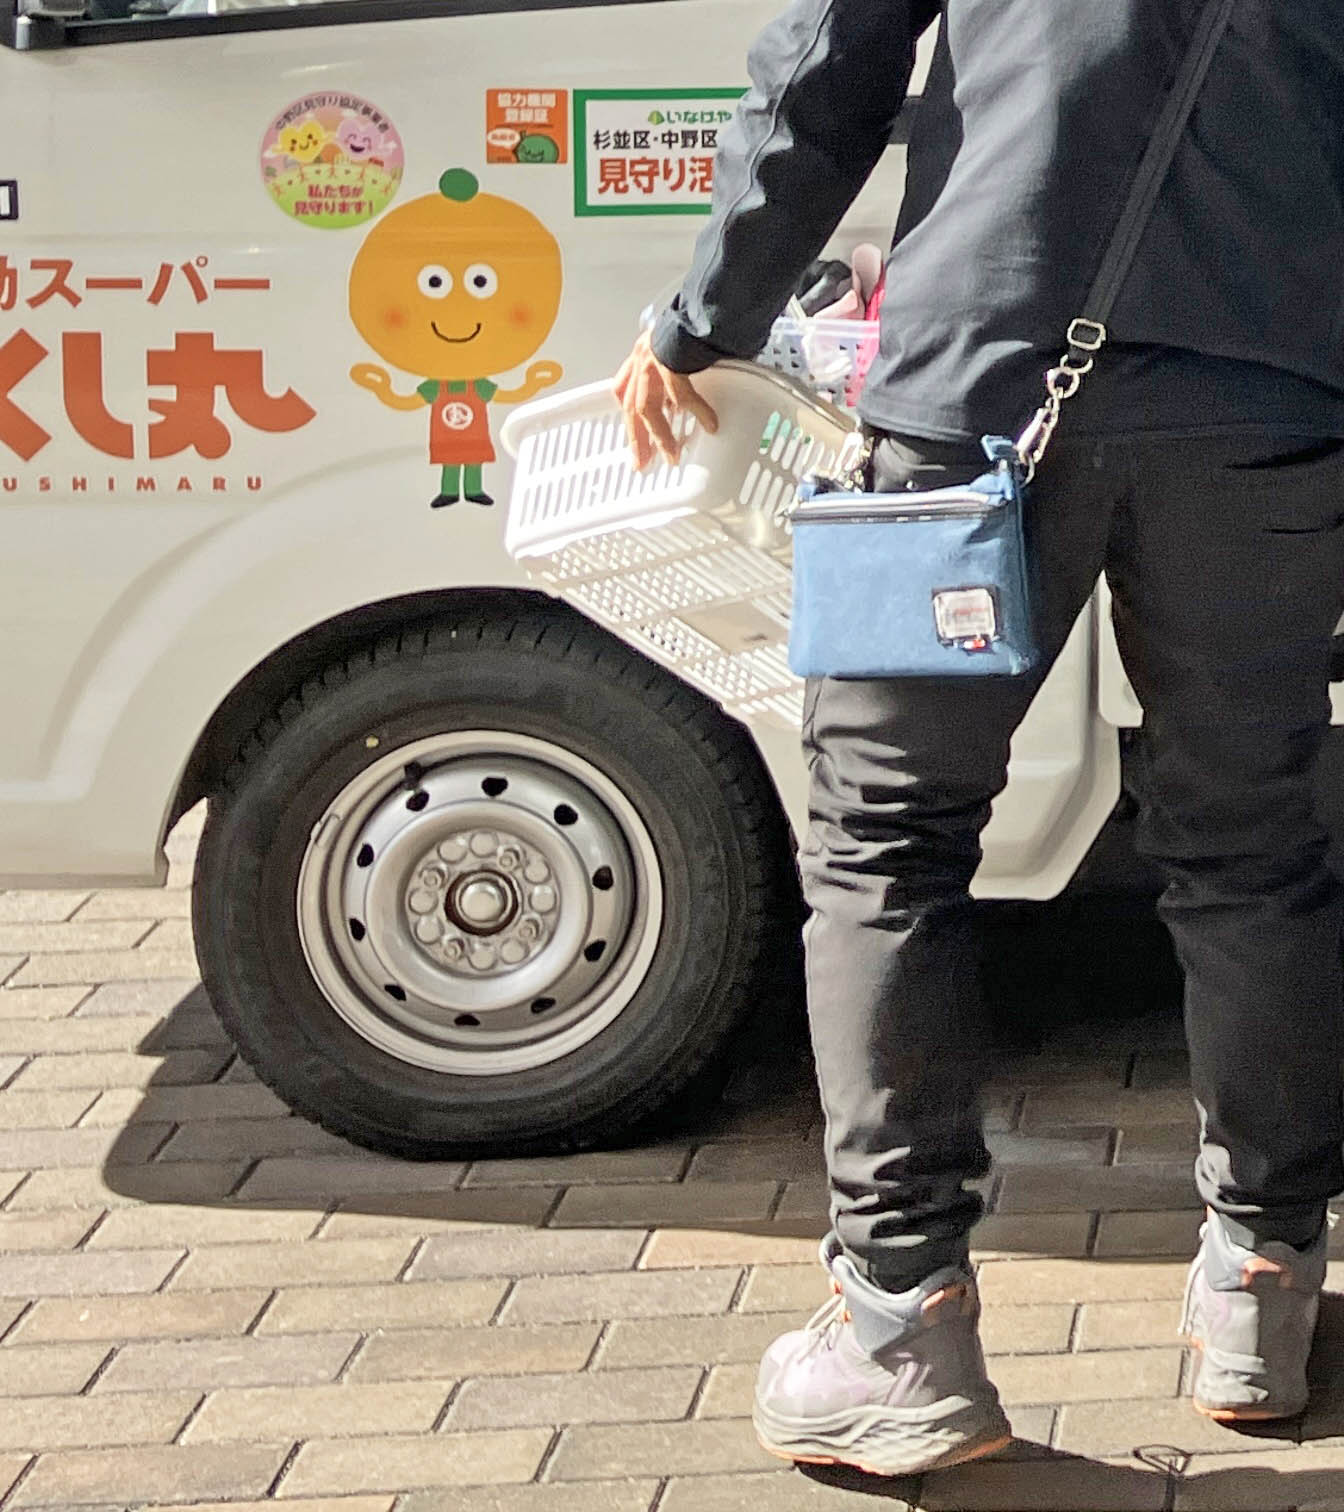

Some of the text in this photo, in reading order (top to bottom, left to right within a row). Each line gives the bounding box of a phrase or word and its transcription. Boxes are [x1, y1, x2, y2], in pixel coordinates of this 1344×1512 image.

[666, 110, 732, 124] いなげや
[593, 129, 718, 150] 杉並区・中野区
[598, 156, 714, 195] 見守り活
